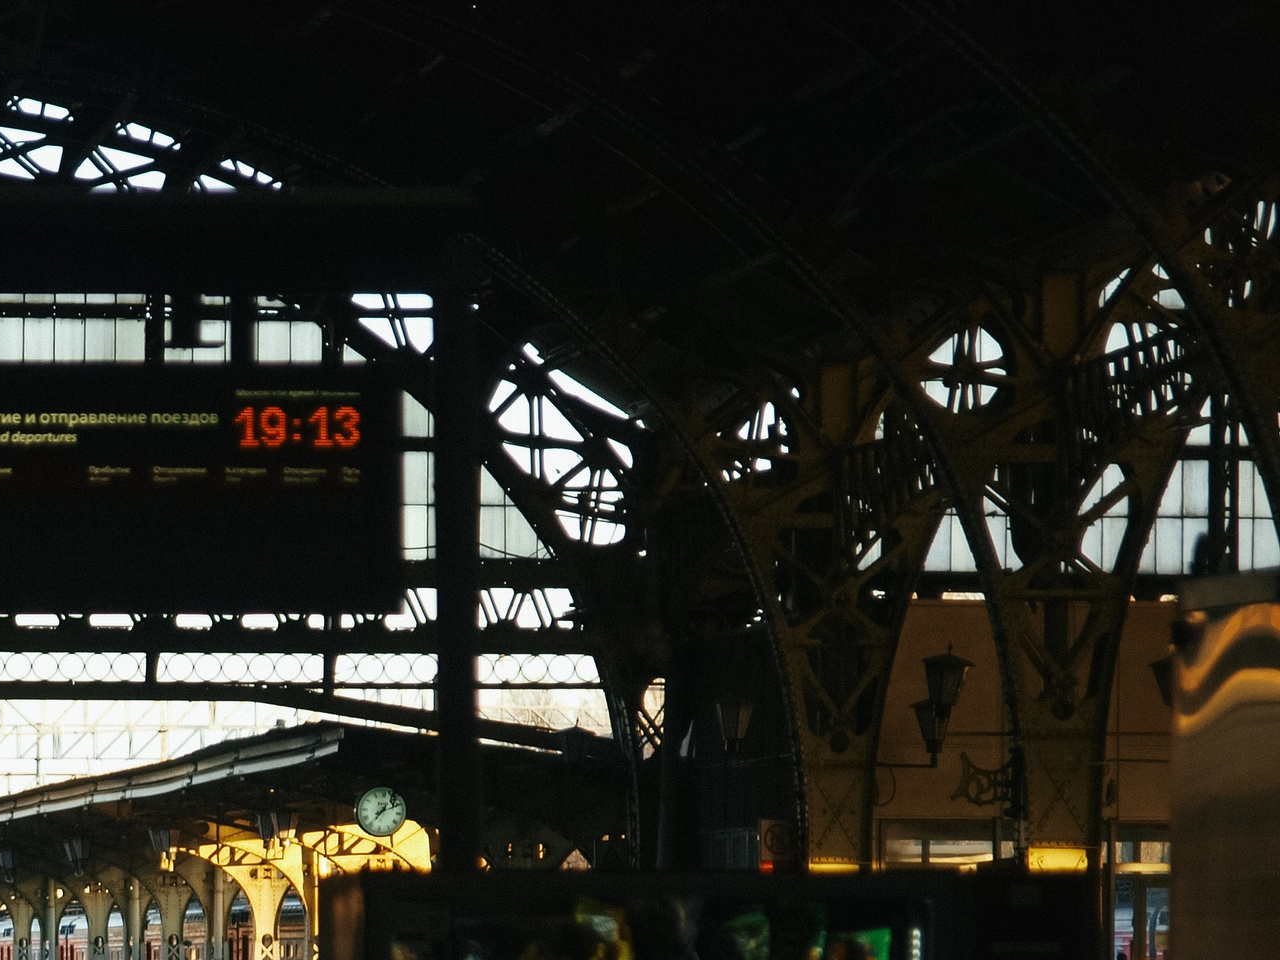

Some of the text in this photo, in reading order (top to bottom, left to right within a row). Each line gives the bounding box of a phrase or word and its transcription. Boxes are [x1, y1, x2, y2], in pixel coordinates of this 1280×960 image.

[25, 414, 37, 424] и
[40, 413, 148, 427] отправление
[152, 413, 218, 426] поездов
[234, 406, 361, 447] 19:13
[11, 431, 78, 445] departures
